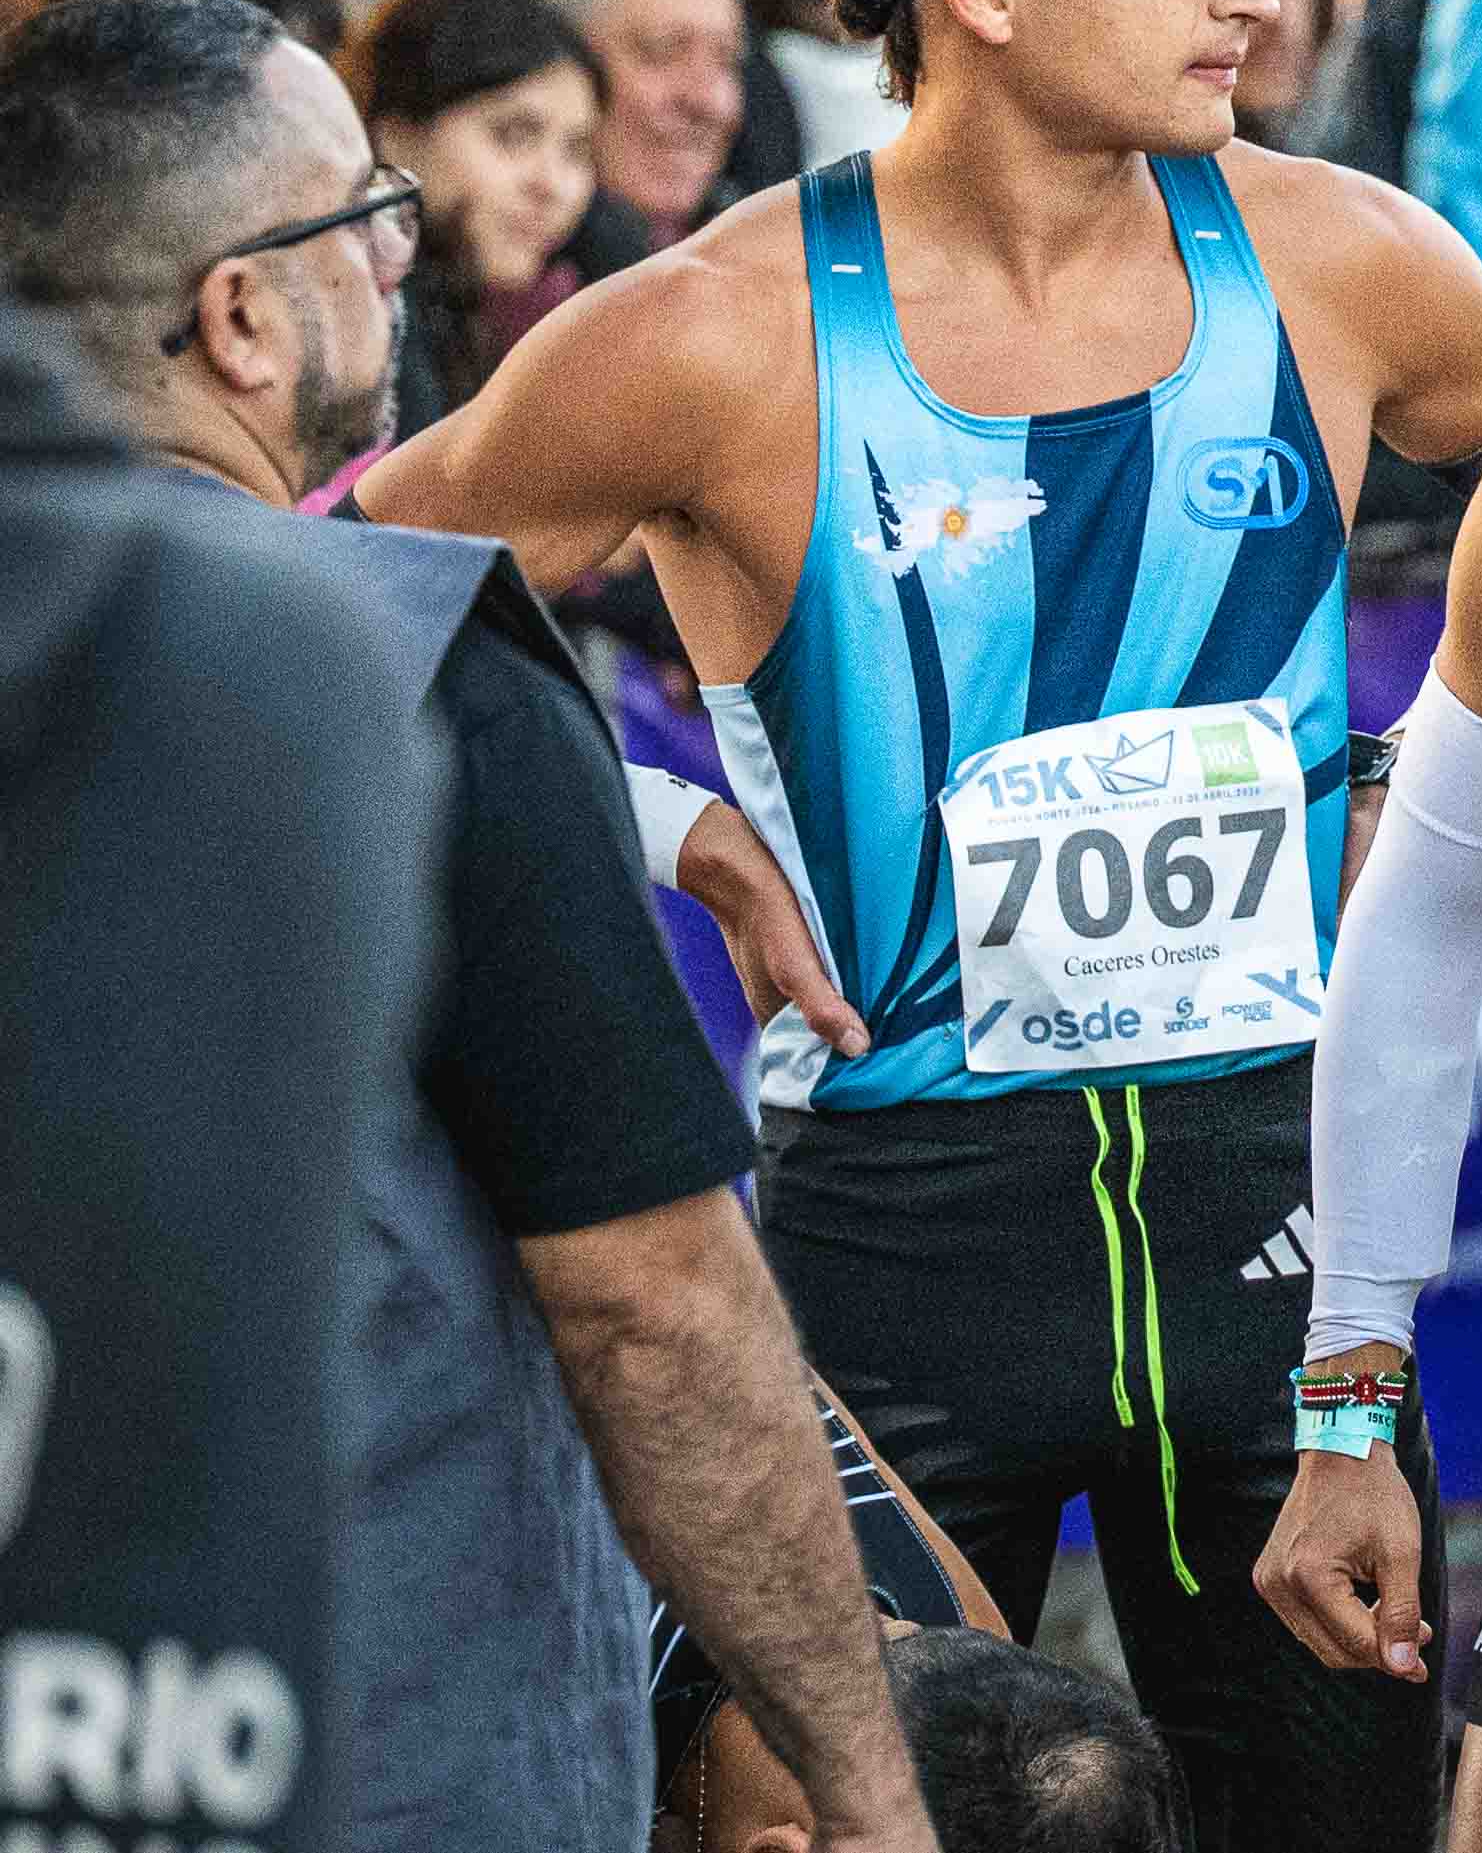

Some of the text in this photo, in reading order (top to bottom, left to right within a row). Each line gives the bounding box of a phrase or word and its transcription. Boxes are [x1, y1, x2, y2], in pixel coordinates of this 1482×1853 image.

[977, 756, 1083, 809] 15K
[966, 807, 1287, 949] 7067
[1063, 942, 1221, 978] Caceres Orestes
[1021, 999, 1142, 1051] osde
